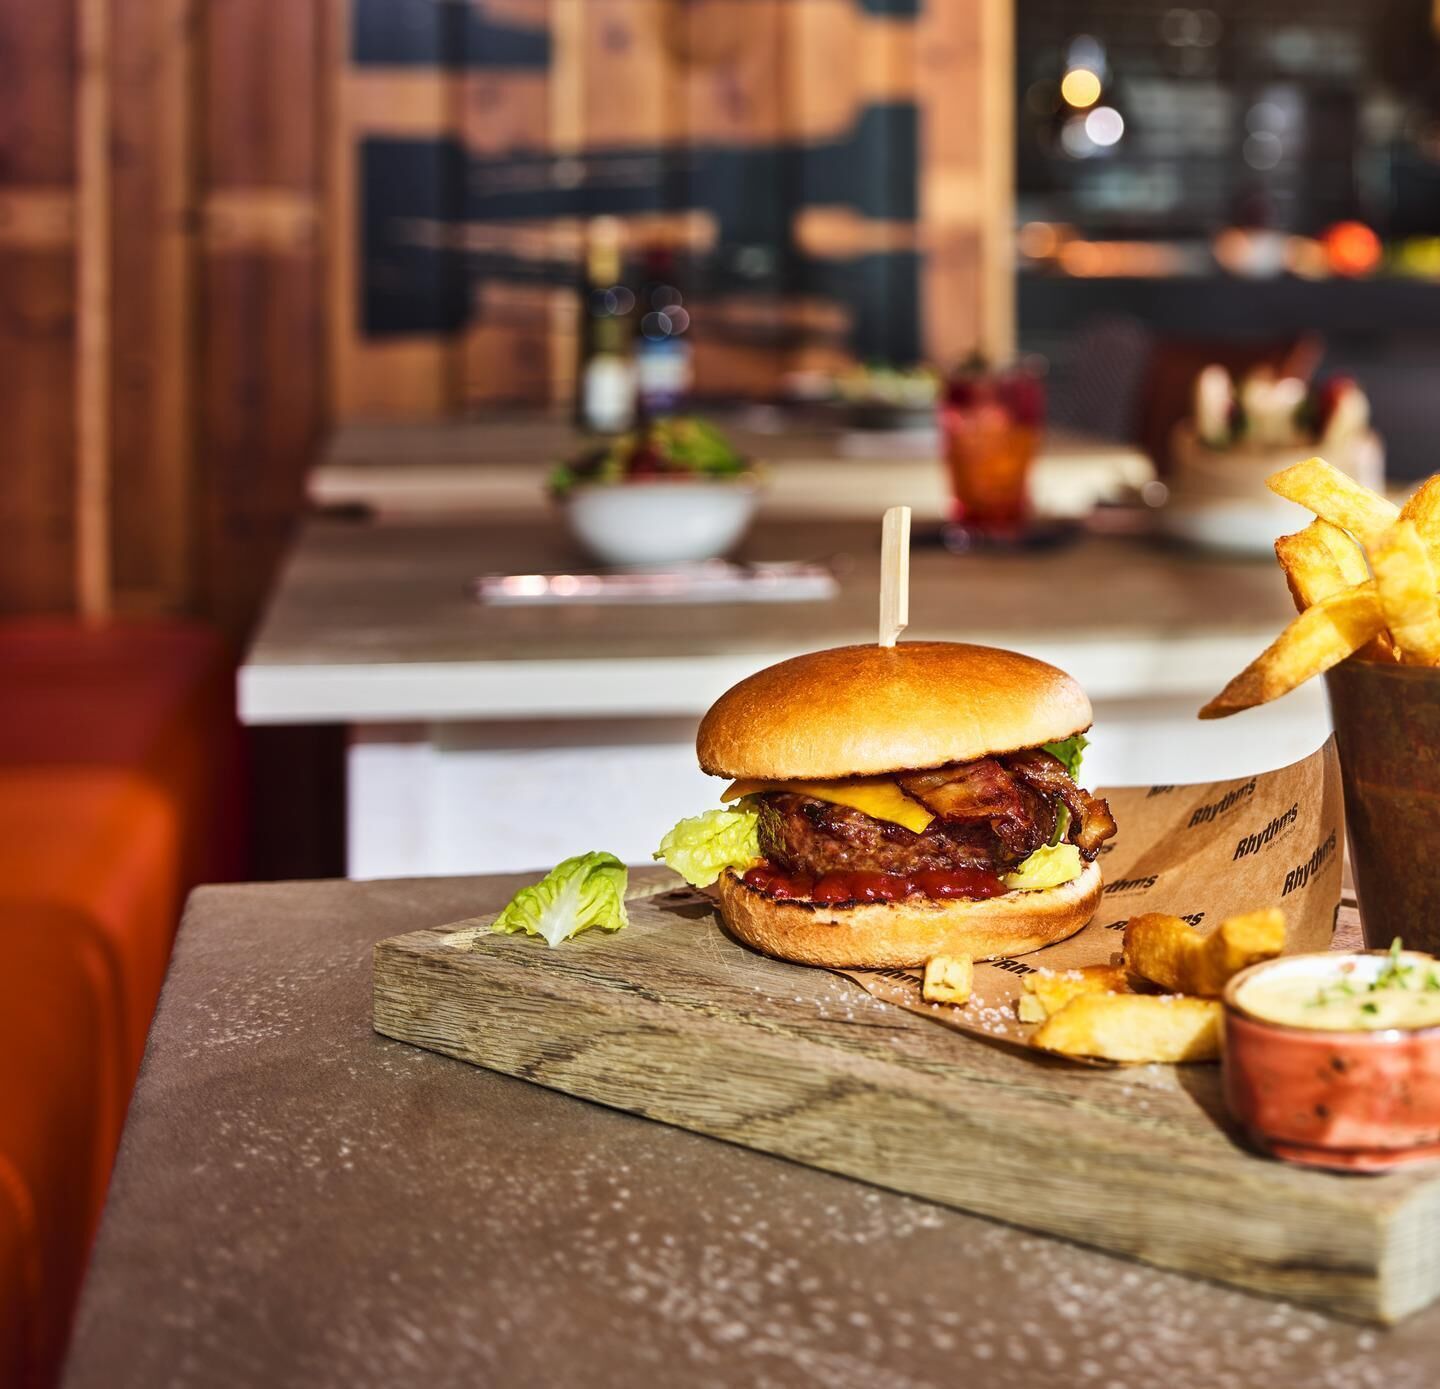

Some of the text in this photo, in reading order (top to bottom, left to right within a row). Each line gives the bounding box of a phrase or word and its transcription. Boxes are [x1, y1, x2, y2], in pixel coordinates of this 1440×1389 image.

[1188, 777, 1257, 828] Rhythms
[1233, 802, 1299, 861] Rhythms
[1103, 874, 1159, 894] thms
[1281, 828, 1337, 897] Rhythms
